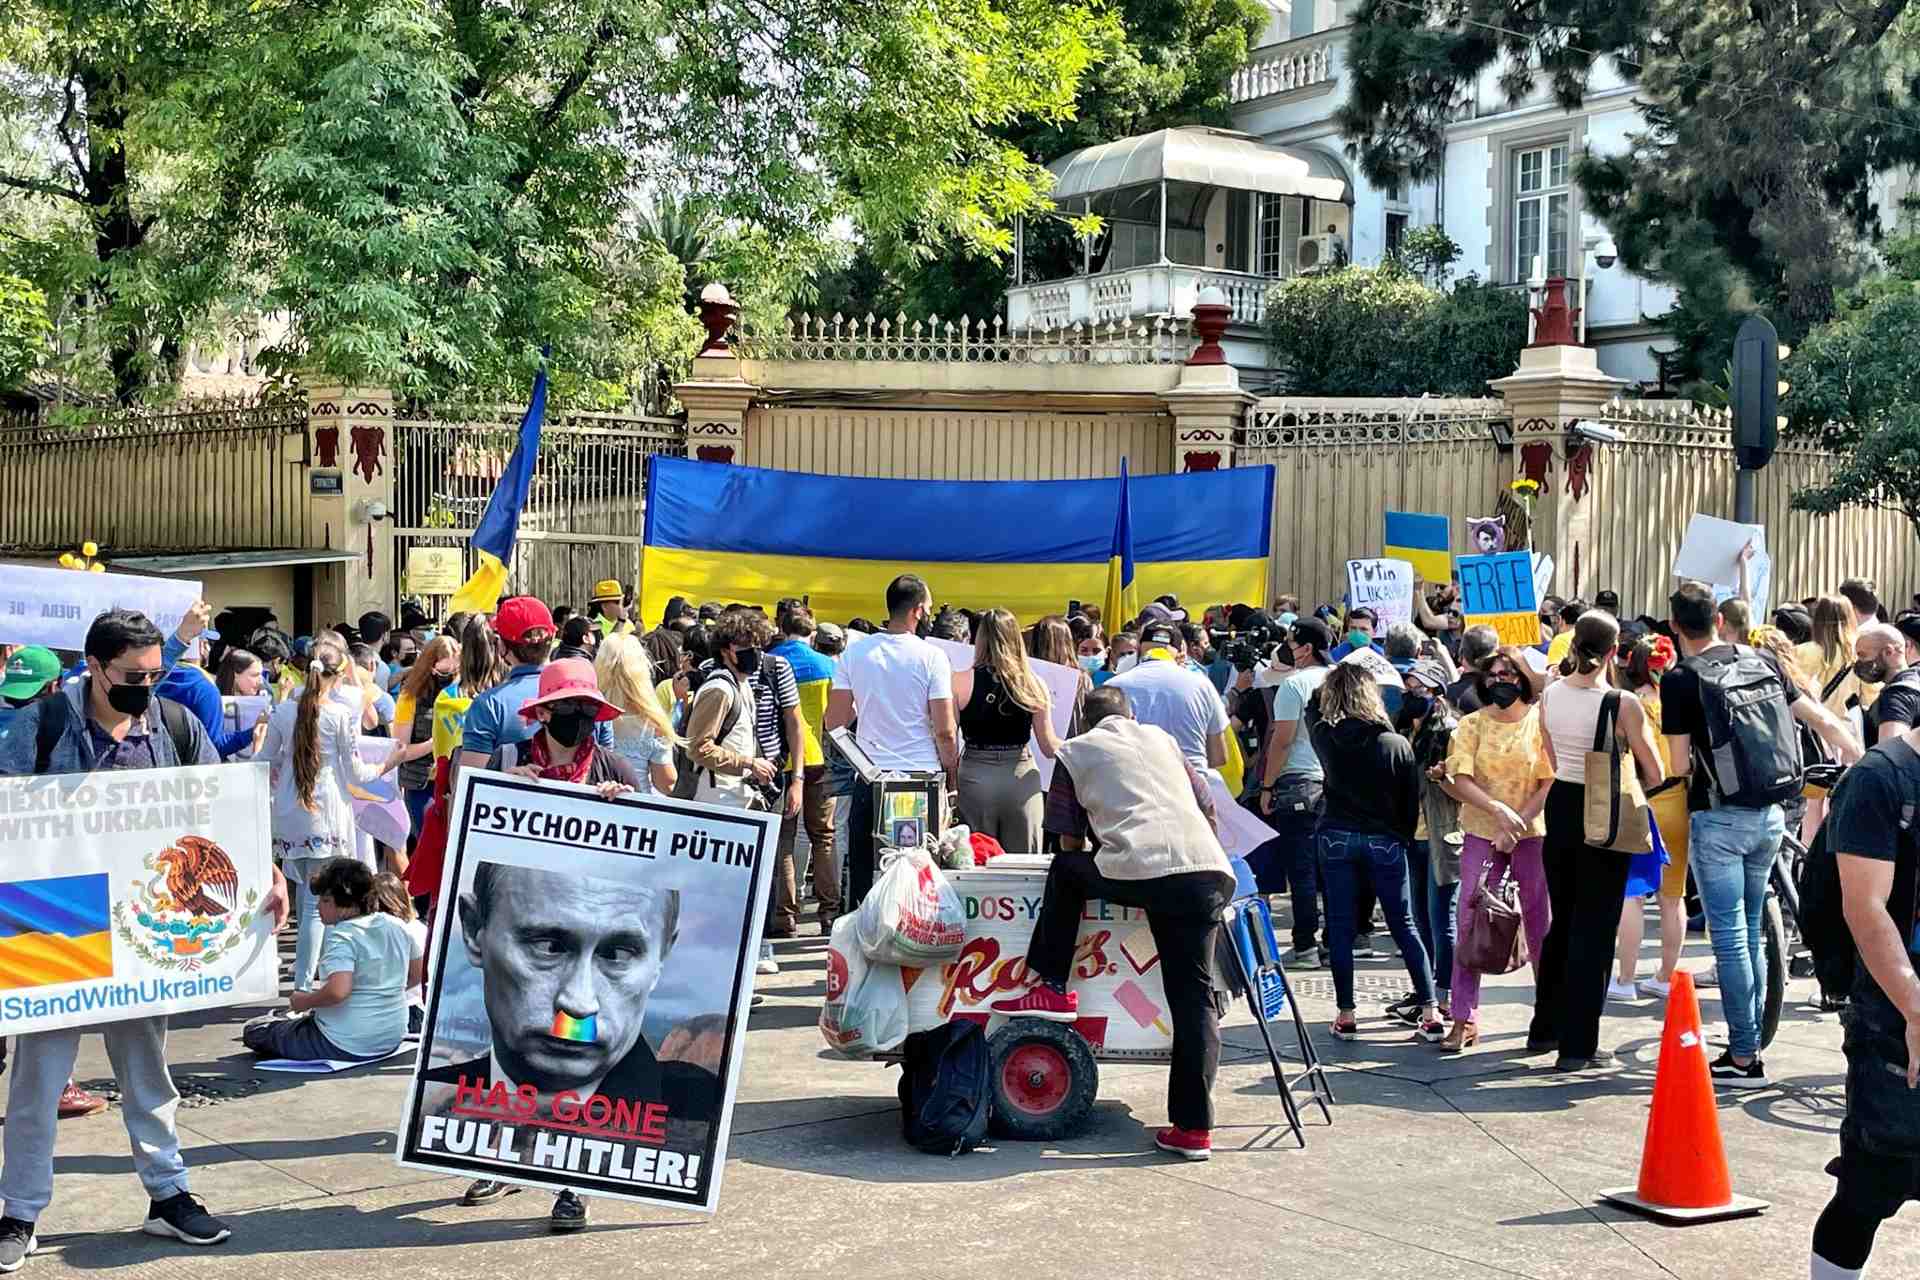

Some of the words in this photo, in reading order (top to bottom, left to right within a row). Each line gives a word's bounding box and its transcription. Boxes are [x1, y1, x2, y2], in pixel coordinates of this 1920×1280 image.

[1350, 560, 1397, 582] Putin
[1459, 559, 1533, 612] FREE
[106, 776, 220, 806] STANDS
[83, 803, 211, 834] UKRAINE
[472, 802, 659, 855] PSYCHOPATH
[669, 829, 757, 869] PÜTIN
[455, 1073, 540, 1117] HAS
[551, 1089, 670, 1136] GONE
[420, 1115, 522, 1163] FULL
[532, 1131, 702, 1188] HITLER!
